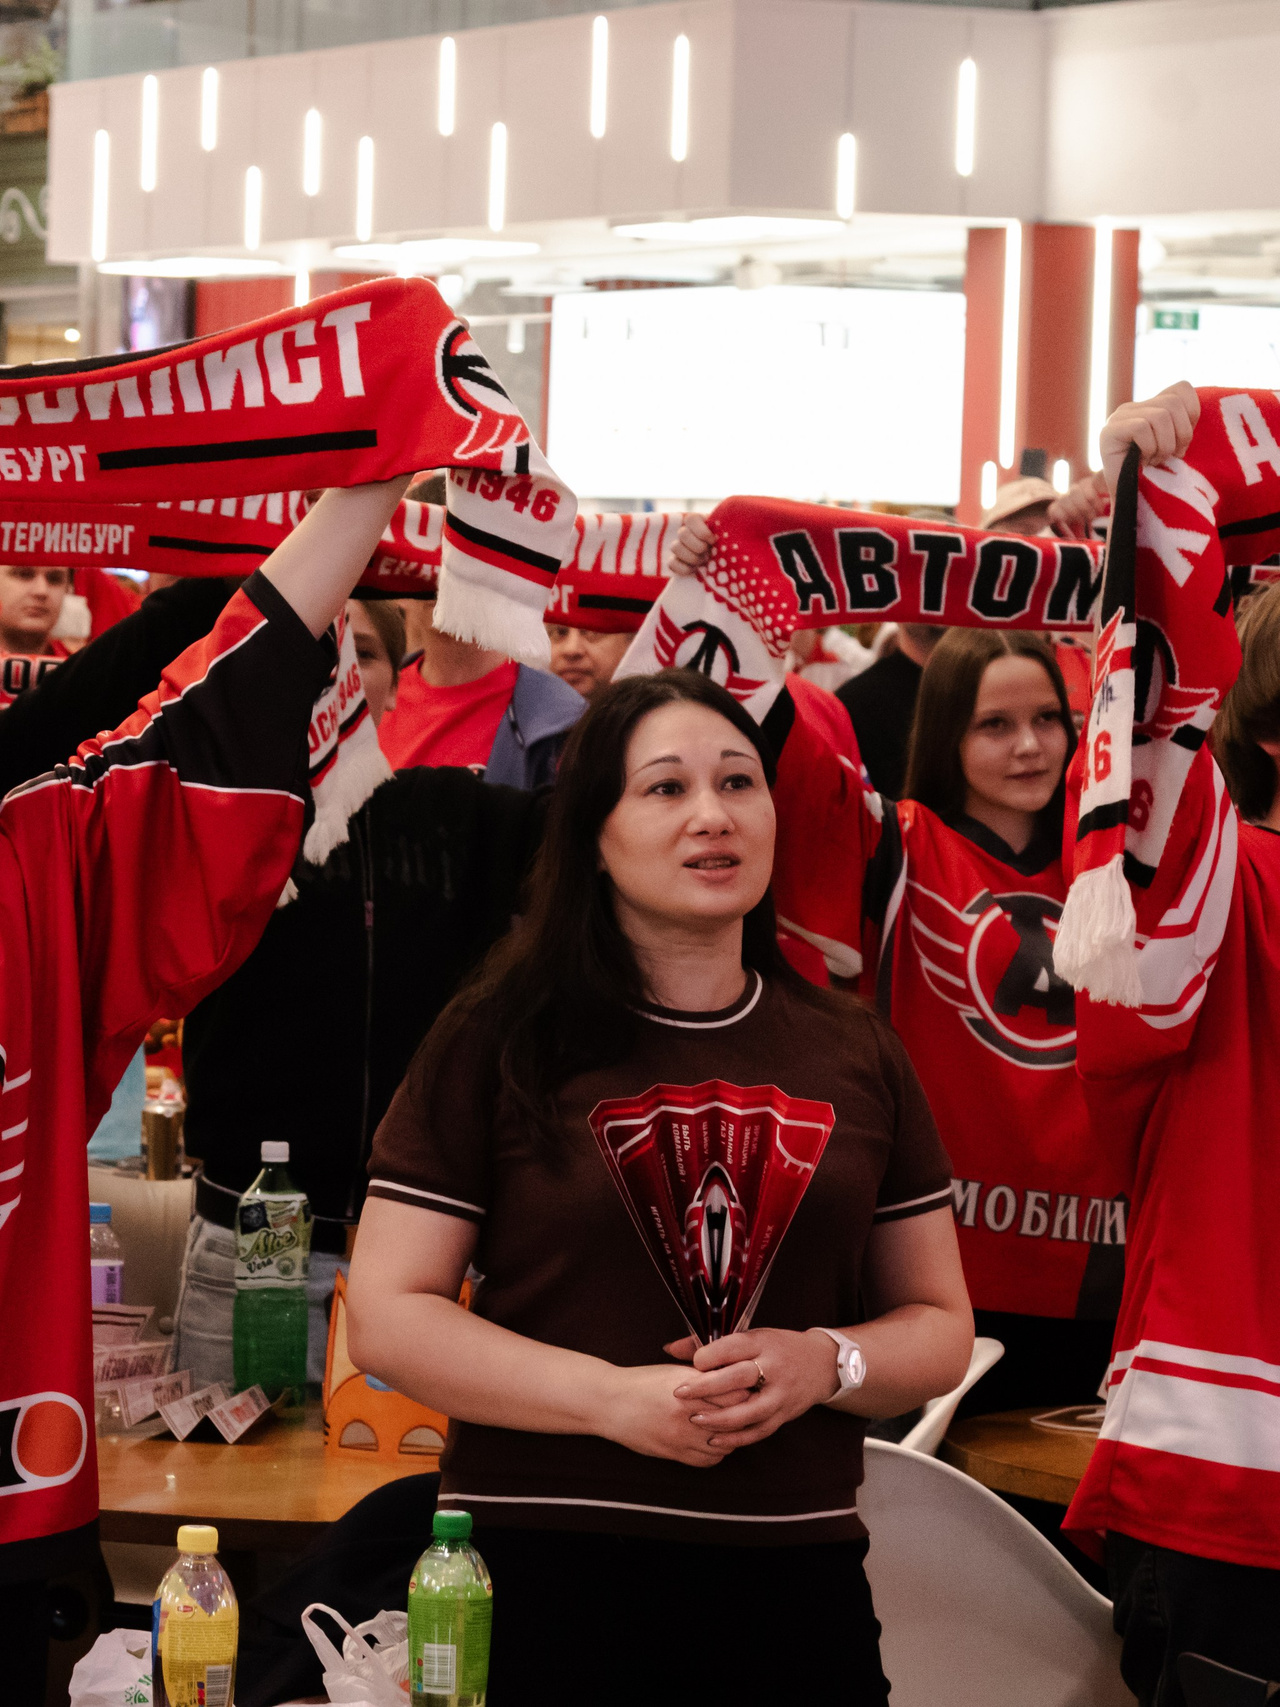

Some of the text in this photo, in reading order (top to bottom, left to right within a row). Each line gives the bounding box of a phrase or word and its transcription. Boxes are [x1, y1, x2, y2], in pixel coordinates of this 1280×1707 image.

[672, 1122, 686, 1174] КОМАНДОЙ
[681, 1124, 691, 1151] БЫТЬ
[726, 1123, 735, 1165] ПОЛНЫЙ
[239, 1228, 297, 1263] Aloe
